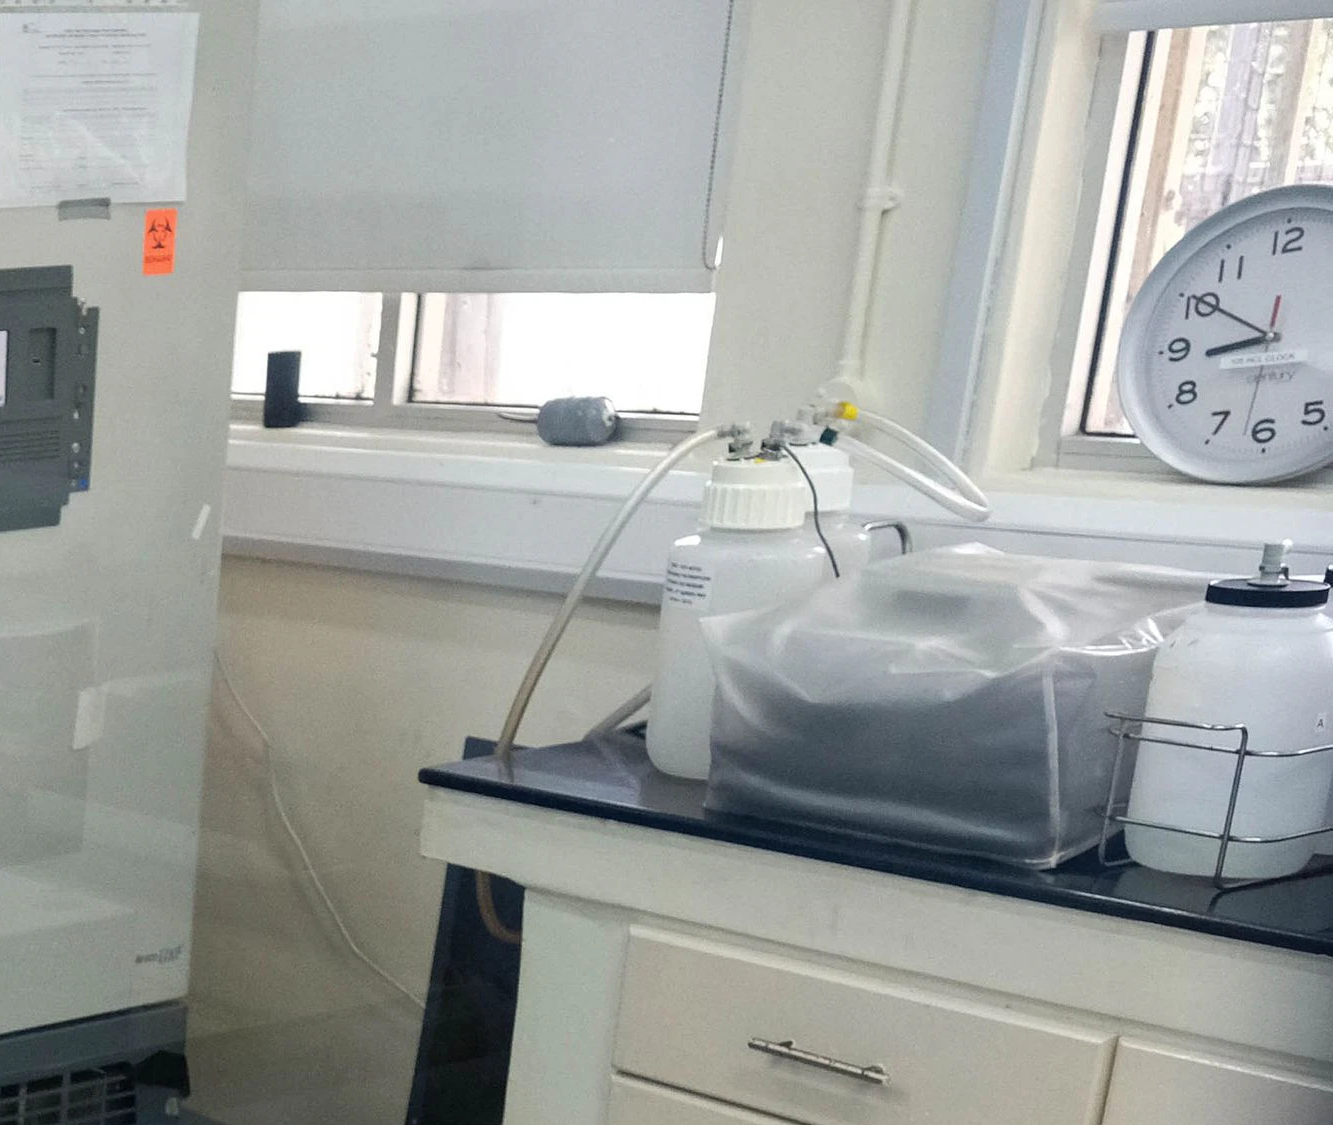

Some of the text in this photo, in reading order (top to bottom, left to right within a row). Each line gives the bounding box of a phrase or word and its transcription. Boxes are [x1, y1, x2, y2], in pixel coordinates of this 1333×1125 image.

[1273, 226, 1305, 255] 12
[1219, 256, 1244, 283] 11
[1185, 292, 1220, 320] 10
[1168, 337, 1191, 362] 9
[1175, 380, 1197, 405] 8
[1212, 410, 1231, 435] 7
[1301, 400, 1326, 426] 5
[1252, 418, 1276, 444] 6
